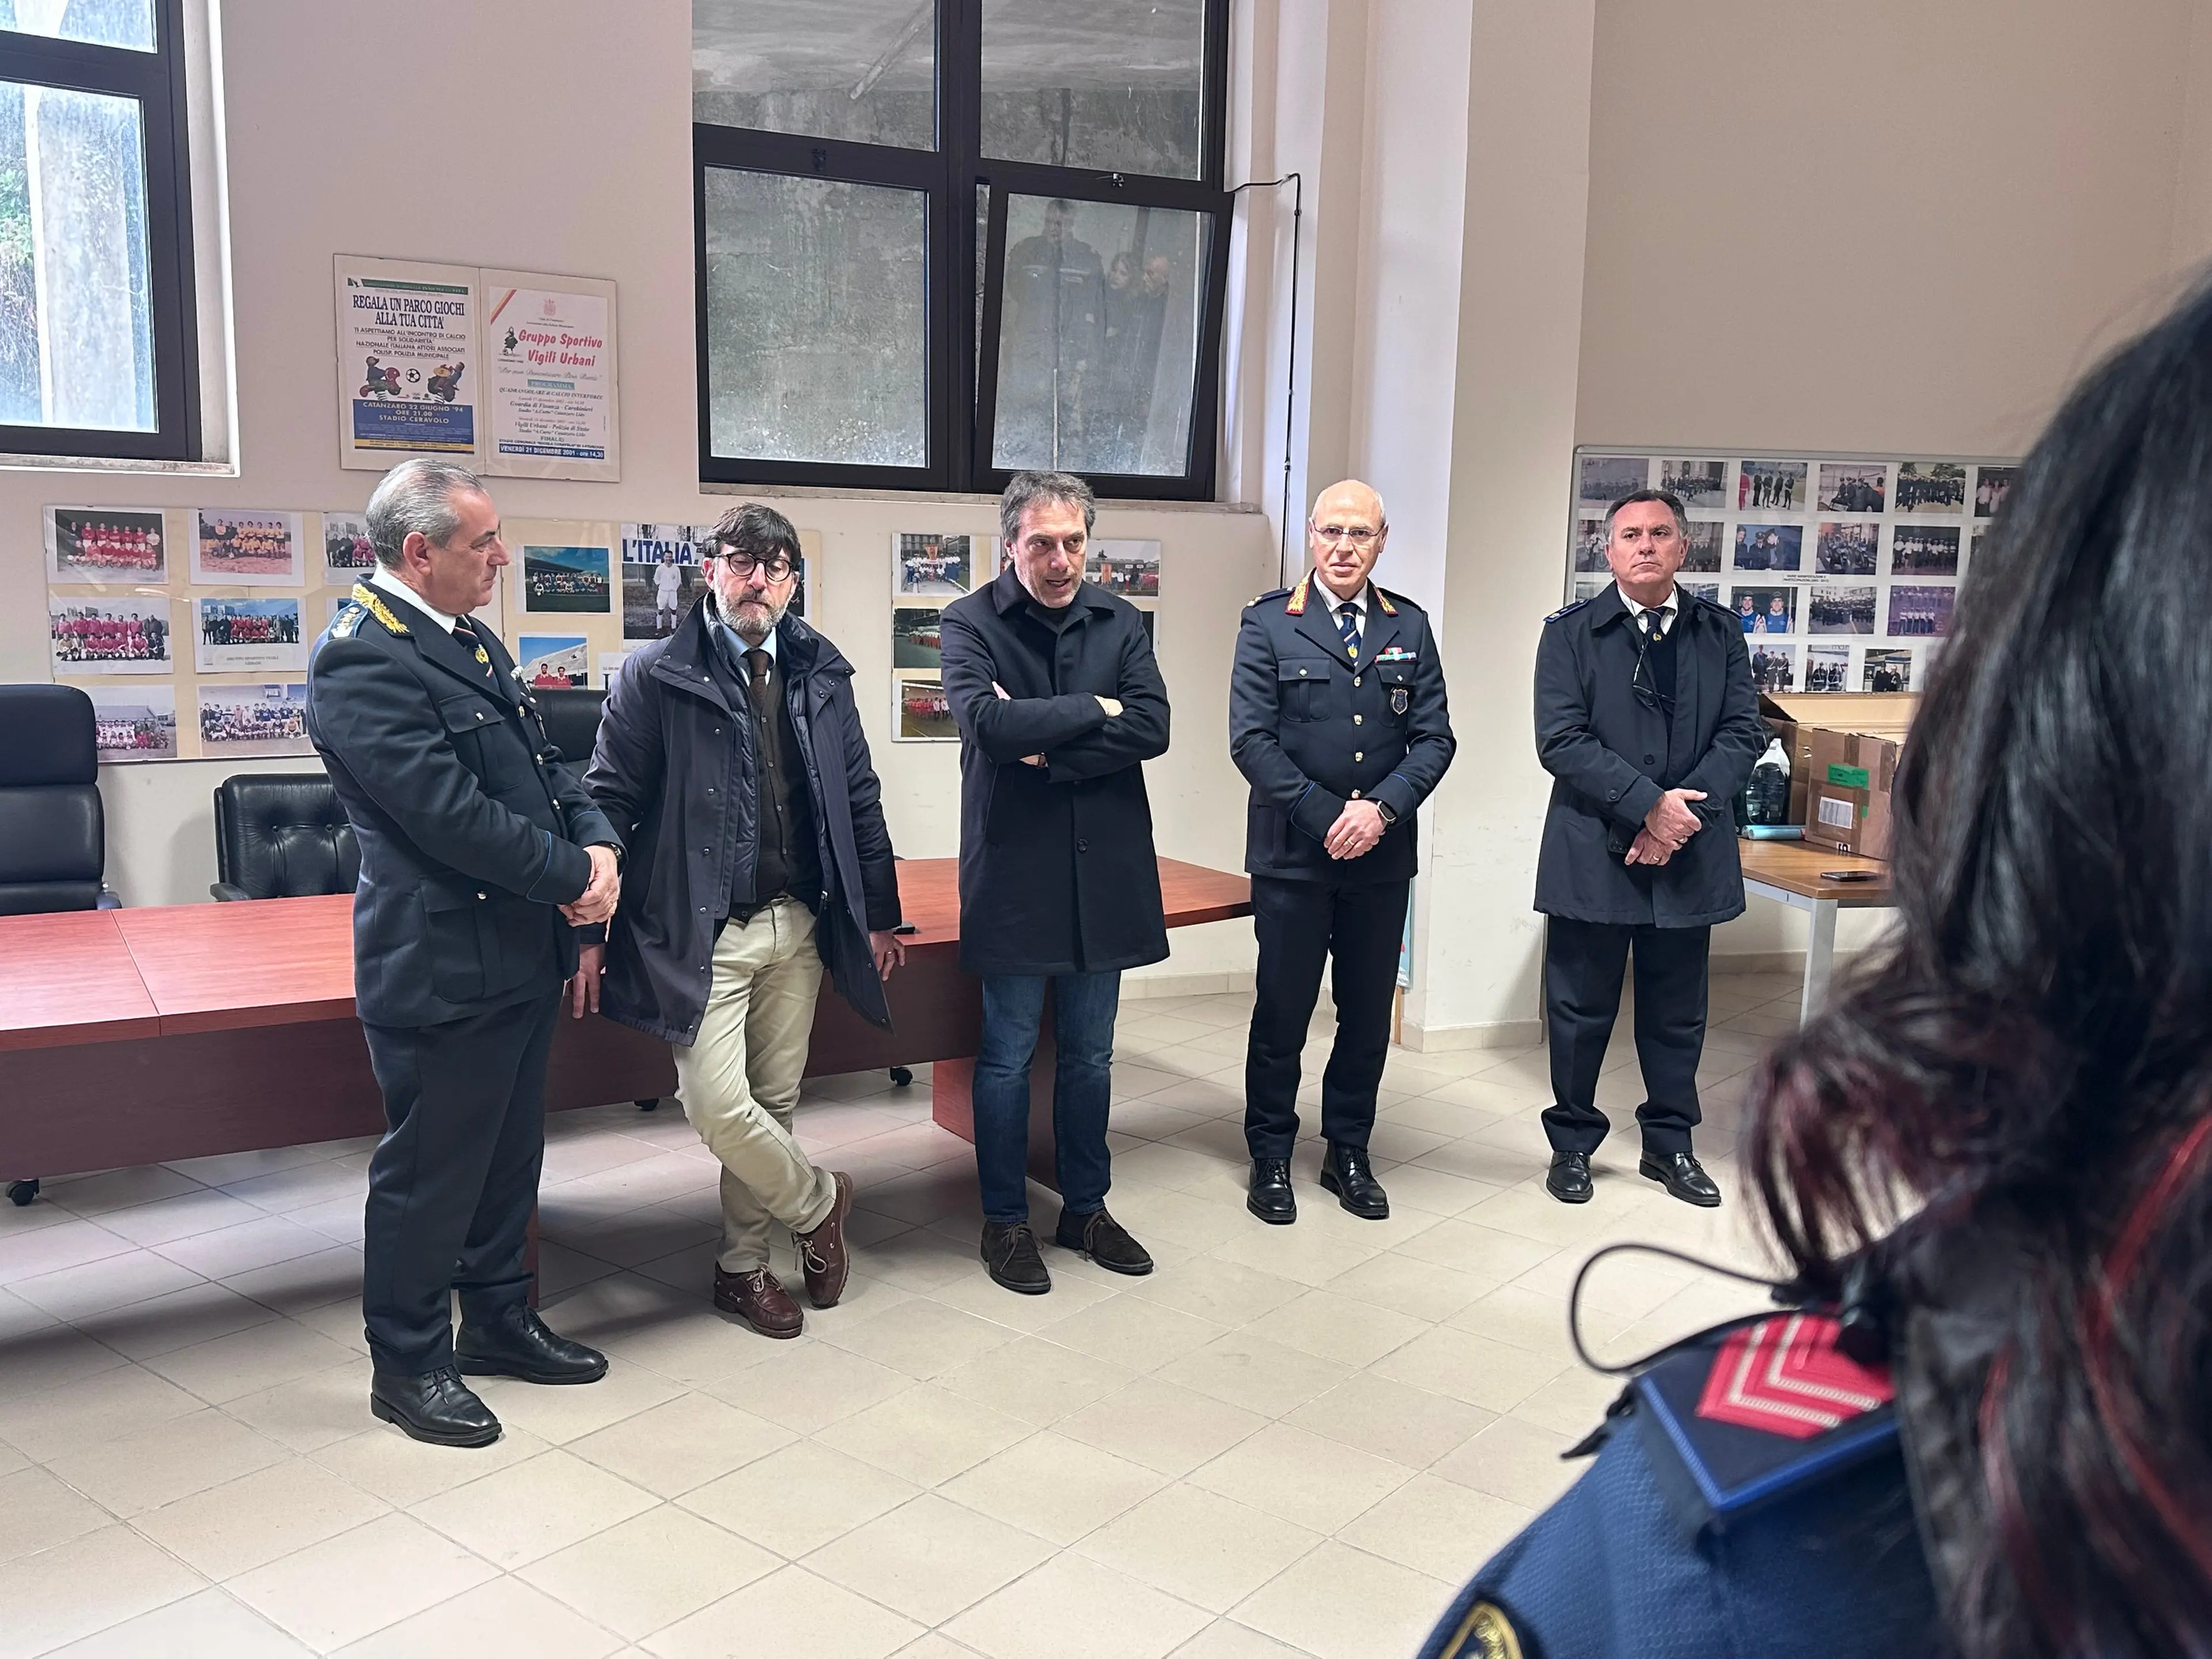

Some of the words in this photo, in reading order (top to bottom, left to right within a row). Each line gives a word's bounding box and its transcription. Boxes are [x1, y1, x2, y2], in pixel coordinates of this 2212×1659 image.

[353, 295, 388, 310] REGALA
[389, 298, 401, 311] UN
[404, 299, 432, 313] PARCO
[434, 301, 464, 316] GIOCHI
[375, 312, 397, 326] ALLA
[399, 313, 418, 327] TUA
[419, 315, 444, 329] CITTA'
[519, 329, 556, 346] Gruppo
[560, 333, 603, 349] Sportivo
[528, 349, 556, 365] Vigili
[560, 353, 596, 366] Urbani
[530, 381, 572, 389] PROGRAMMA
